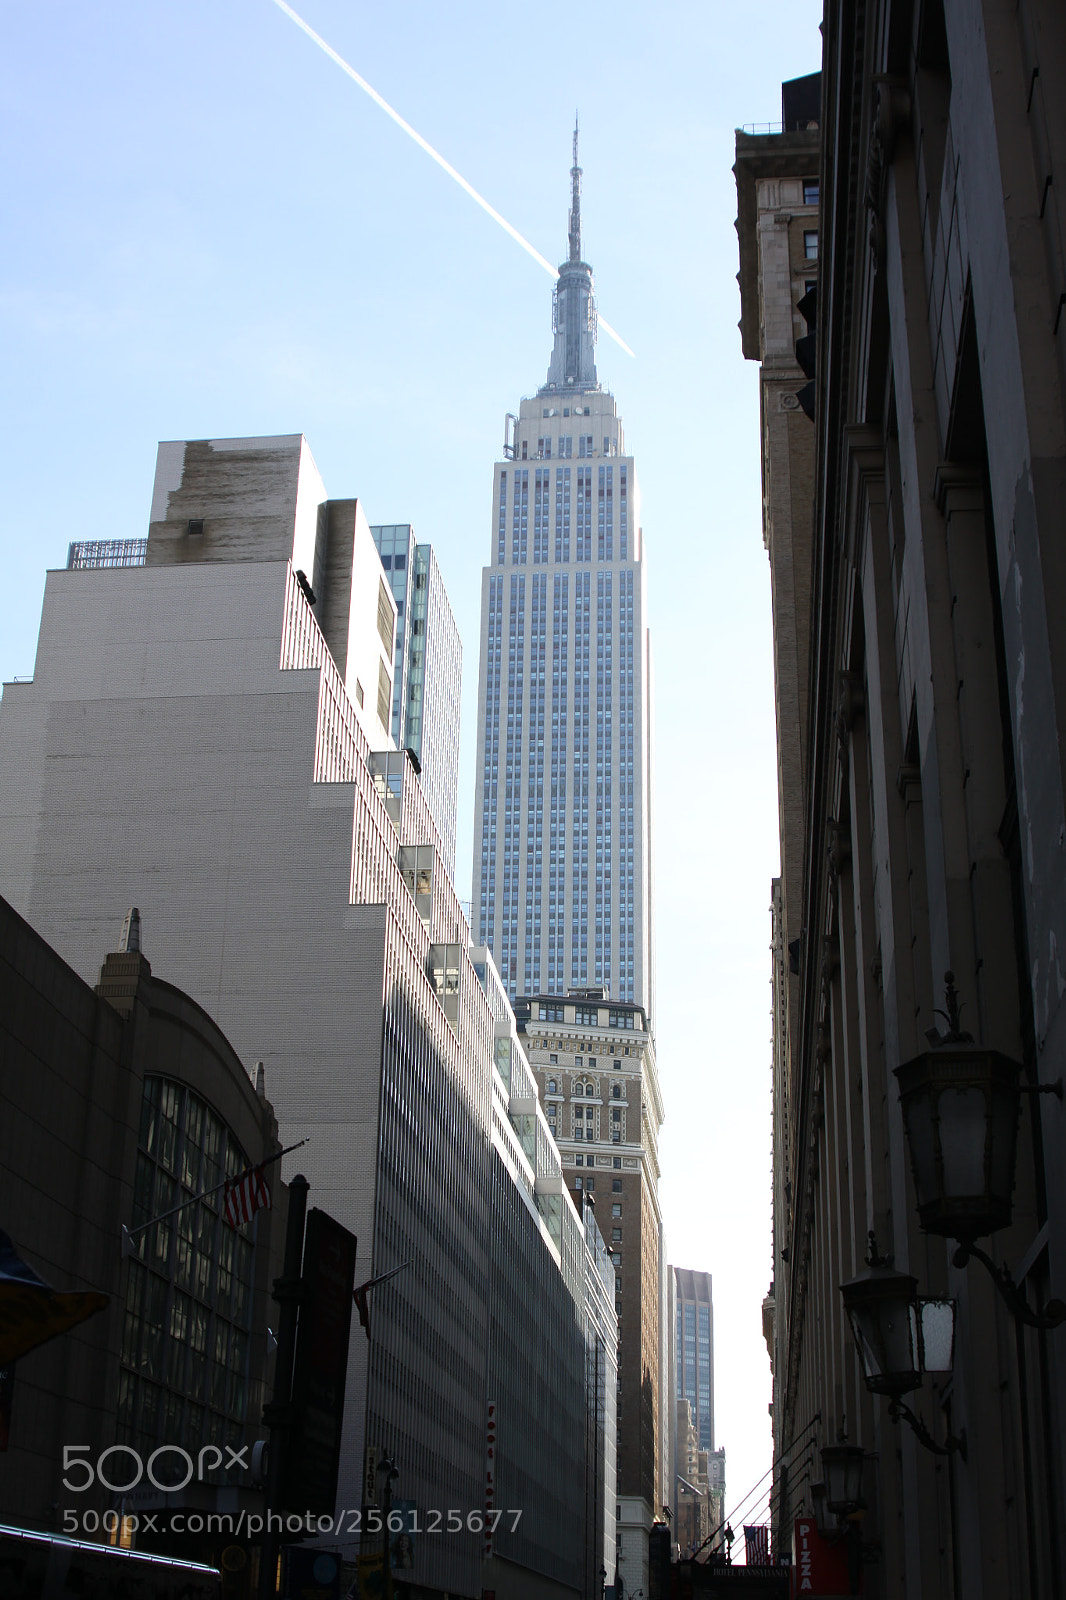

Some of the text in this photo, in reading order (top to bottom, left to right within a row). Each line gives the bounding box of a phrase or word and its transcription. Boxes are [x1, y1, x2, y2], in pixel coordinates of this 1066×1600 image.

[713, 1568, 788, 1577] HOTEL PENNSYLVANIA
[799, 1524, 813, 1590] PIZZA
